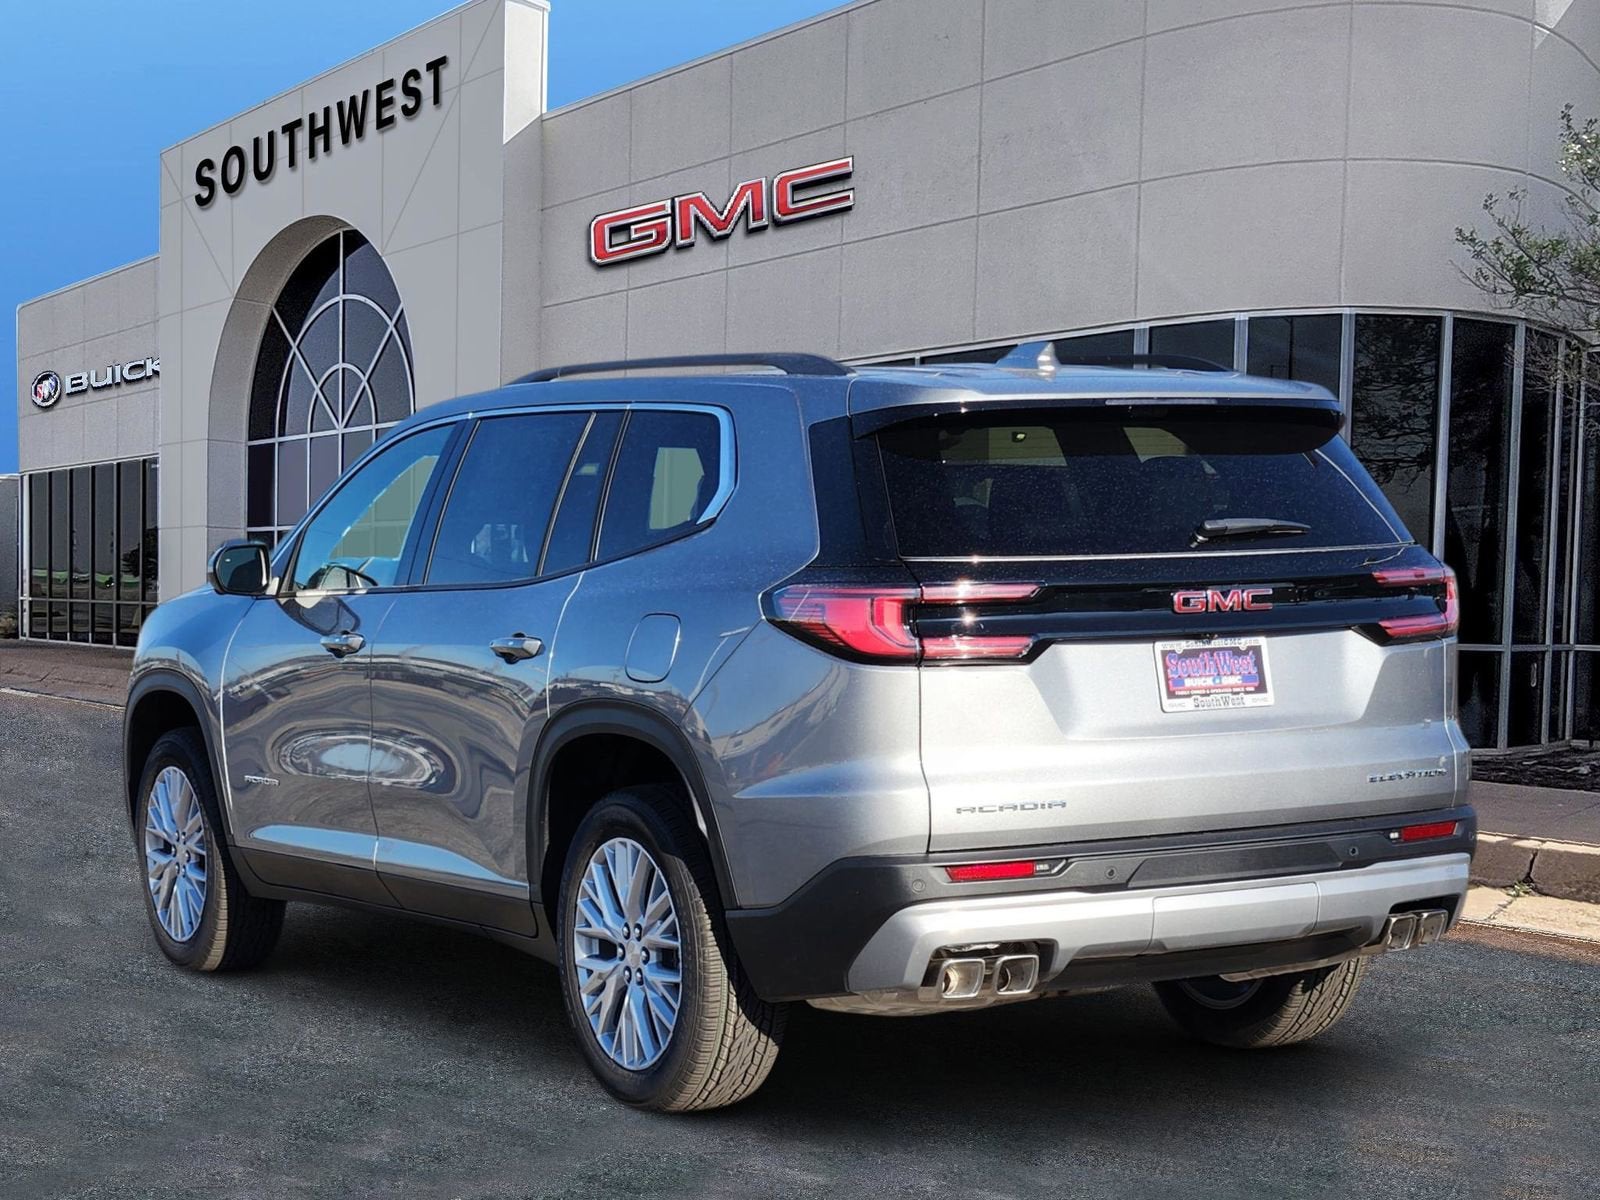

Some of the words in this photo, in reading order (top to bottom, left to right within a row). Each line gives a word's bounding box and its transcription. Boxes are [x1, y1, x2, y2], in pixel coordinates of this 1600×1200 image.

[194, 55, 448, 208] SOUTHWEST
[590, 155, 854, 265] GMC
[1173, 588, 1273, 613] GMC
[1165, 650, 1258, 679] SouthWest
[1193, 695, 1246, 708] SouthWest
[1367, 767, 1448, 783] ELEVATION
[956, 800, 1067, 814] ACADIA
